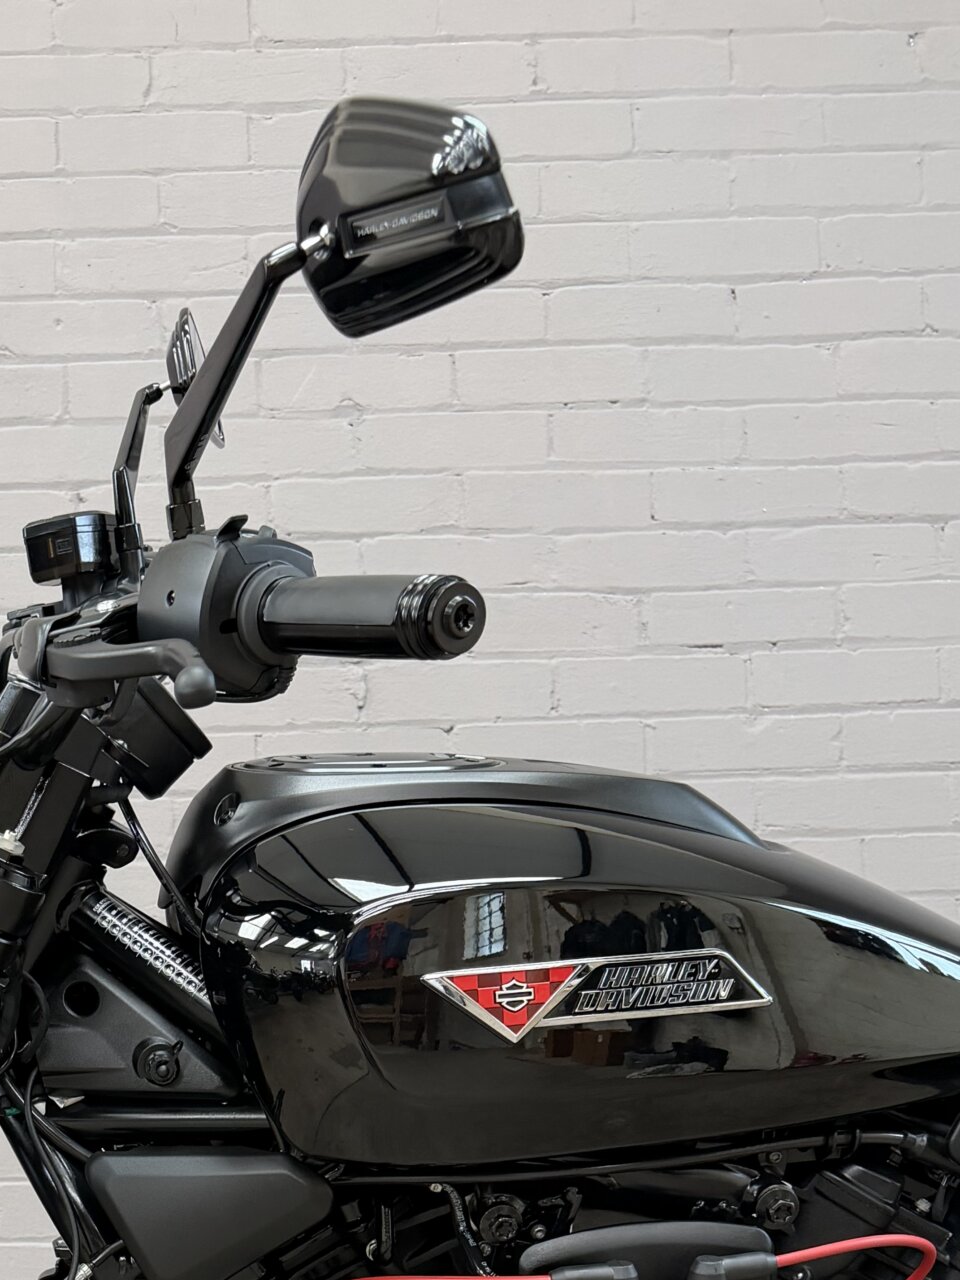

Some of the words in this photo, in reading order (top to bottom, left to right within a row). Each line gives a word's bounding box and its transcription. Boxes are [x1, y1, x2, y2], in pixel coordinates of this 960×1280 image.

[357, 208, 439, 238] HARLEY-DAVIDSON
[599, 959, 719, 989] HARLEY-
[574, 979, 735, 1013] DAVIDSON
